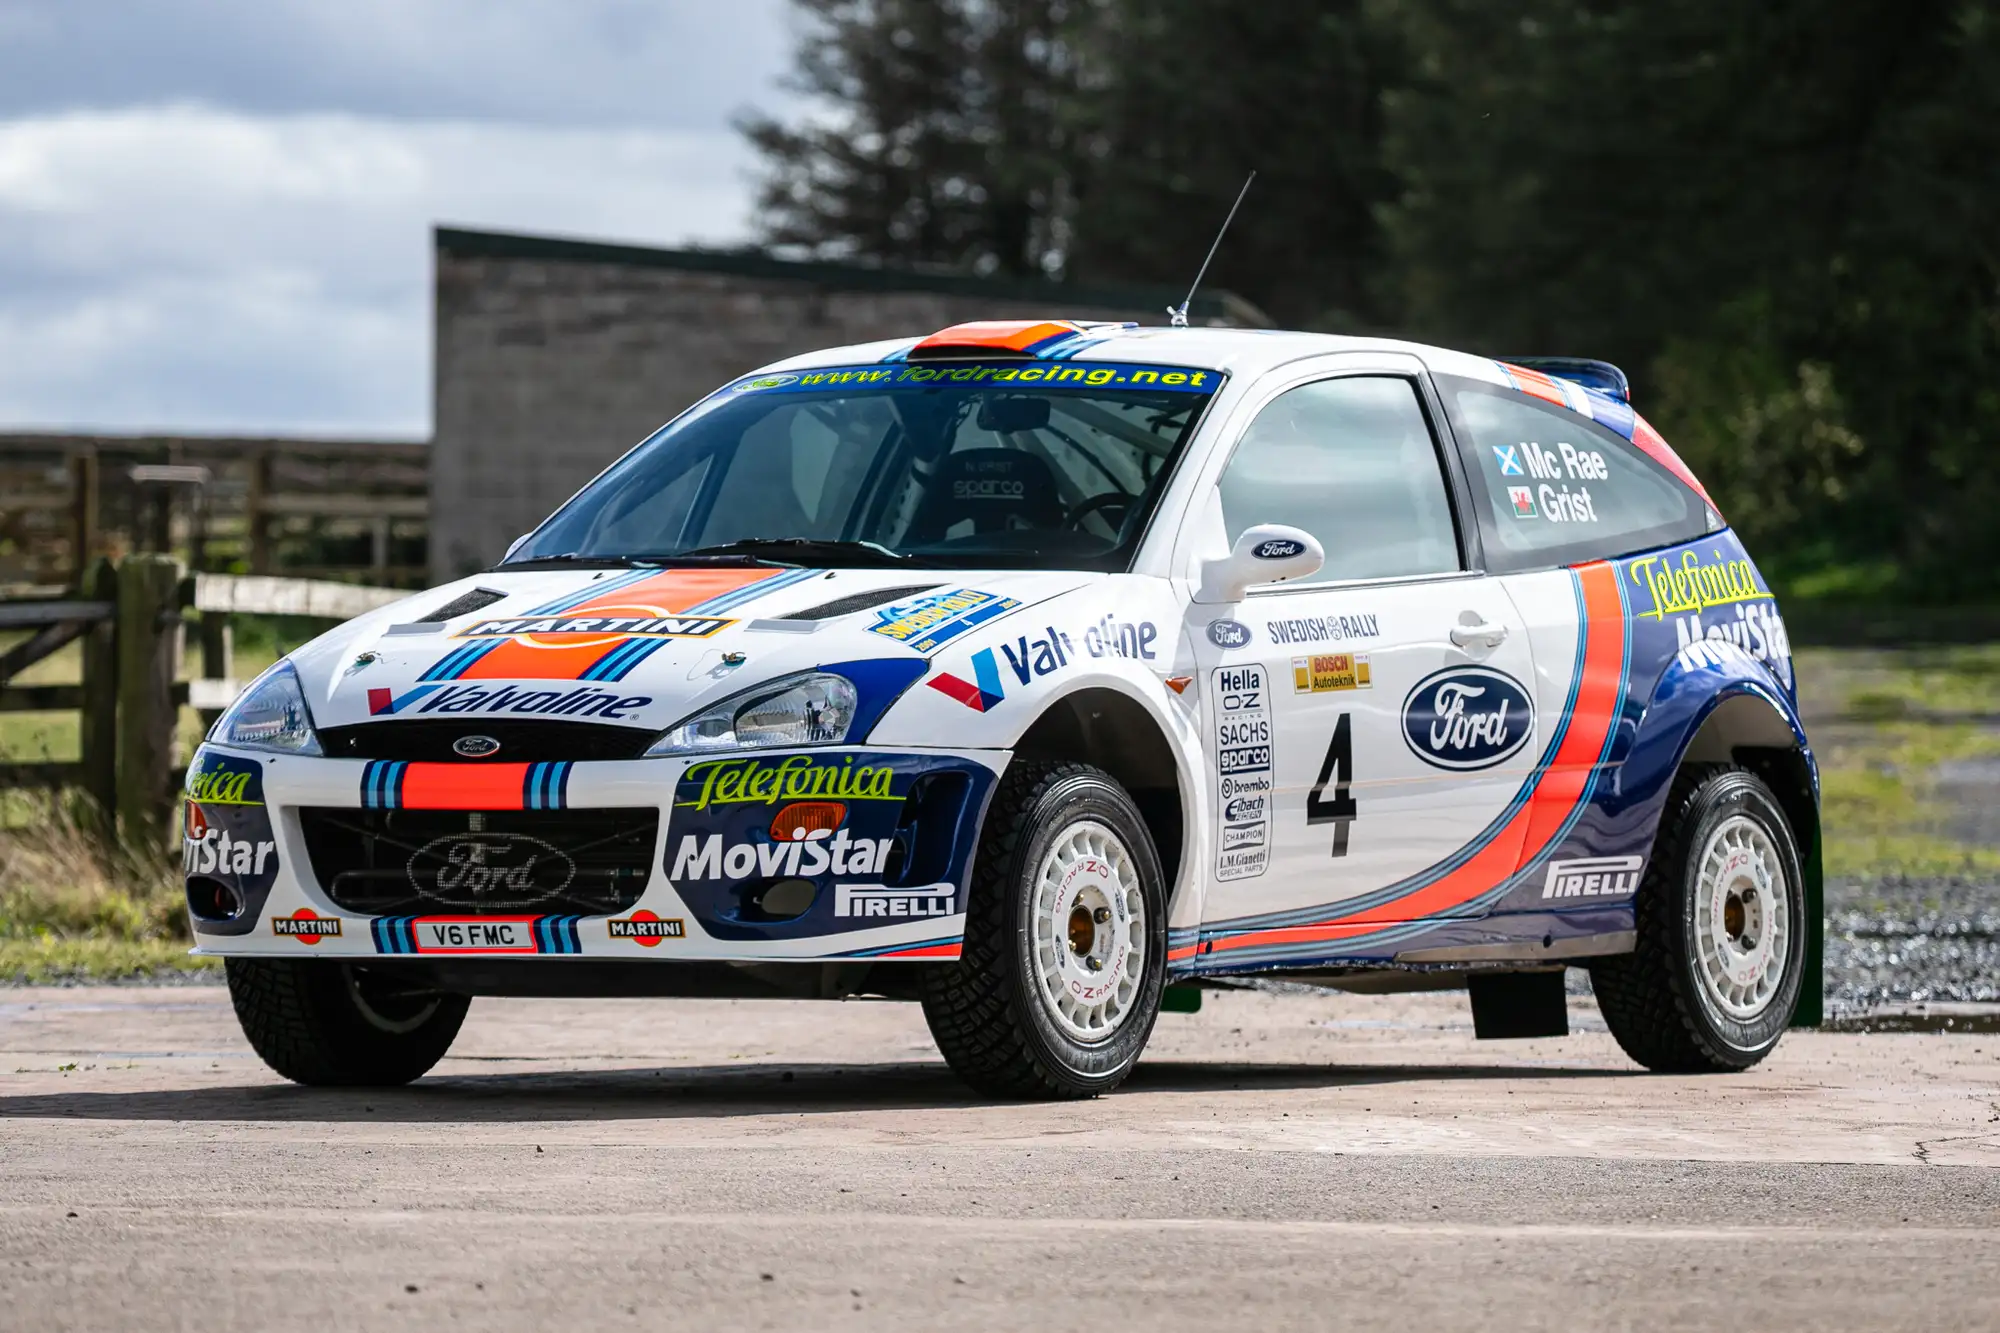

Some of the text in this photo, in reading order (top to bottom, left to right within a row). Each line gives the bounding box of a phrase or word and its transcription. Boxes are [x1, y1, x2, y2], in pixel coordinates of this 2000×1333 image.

[800, 365, 1207, 387] www.fordracing.net
[1520, 442, 1608, 481] Mc Rae
[953, 479, 1024, 500] sparco
[1538, 484, 1598, 523] Grist
[1261, 540, 1296, 557] Ford
[474, 618, 714, 634] MARTINI
[1215, 623, 1243, 644] Ford
[1267, 614, 1380, 644] SWEDISH RALLY
[1313, 656, 1349, 673] BOSCH
[1221, 669, 1260, 692] Hella
[1313, 674, 1356, 689] Autoteknik
[417, 685, 653, 719] Valvoline
[1430, 682, 1508, 750] Ford
[1220, 721, 1269, 746] SACHS
[462, 739, 488, 753] Ford
[1220, 747, 1270, 772] sparco
[1234, 777, 1270, 793] brembo
[1307, 713, 1357, 858] 4
[1225, 794, 1265, 821] Eibach
[1226, 829, 1263, 843] CHAMPION
[670, 827, 893, 881] MoviStar
[437, 843, 538, 892] Ford
[1542, 855, 1644, 899] PIRELLI
[834, 883, 956, 917] PIRELLI
[275, 920, 338, 934] MARTINI
[432, 925, 515, 946] V6 FMC
[611, 922, 681, 936] MARTINI
